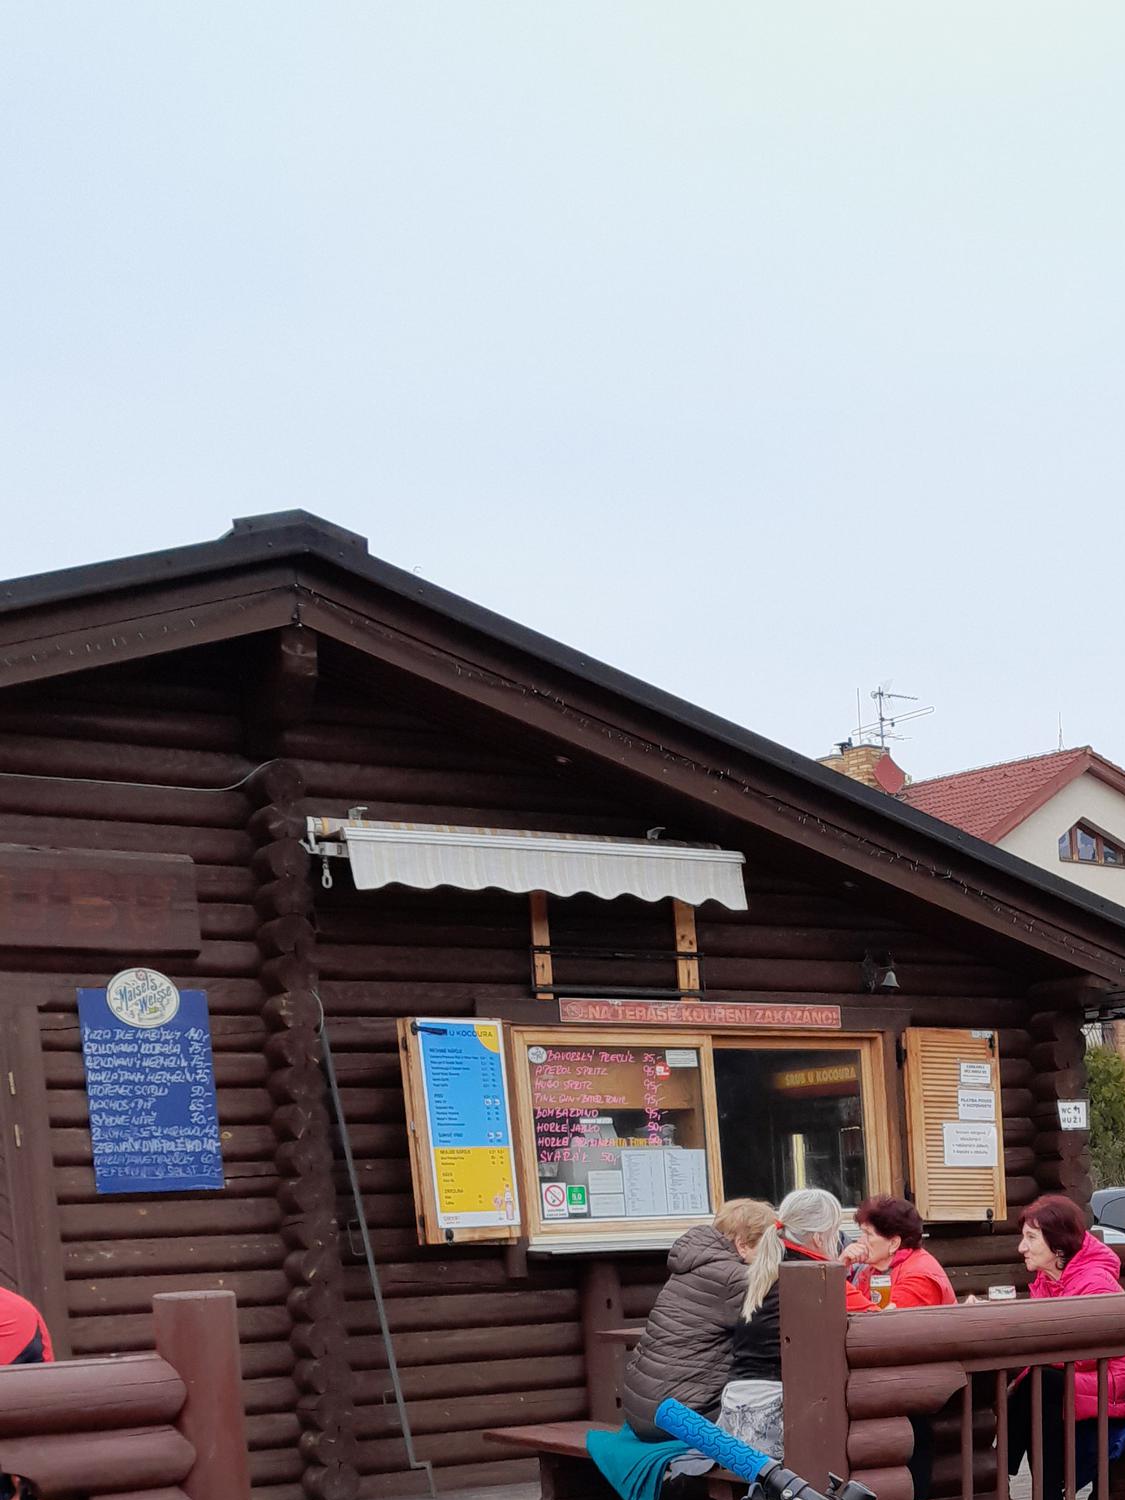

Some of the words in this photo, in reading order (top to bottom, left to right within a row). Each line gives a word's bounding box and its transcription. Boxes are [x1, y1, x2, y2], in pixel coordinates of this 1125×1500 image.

[588, 1006, 609, 1018] NA
[616, 1006, 678, 1020] TERASE
[547, 1049, 595, 1062] BAVORSKÝ
[535, 1065, 571, 1076] APEROL
[576, 1065, 608, 1076] SPRITZ
[535, 1079, 559, 1090] HUGO
[563, 1079, 593, 1090] SPRITZ
